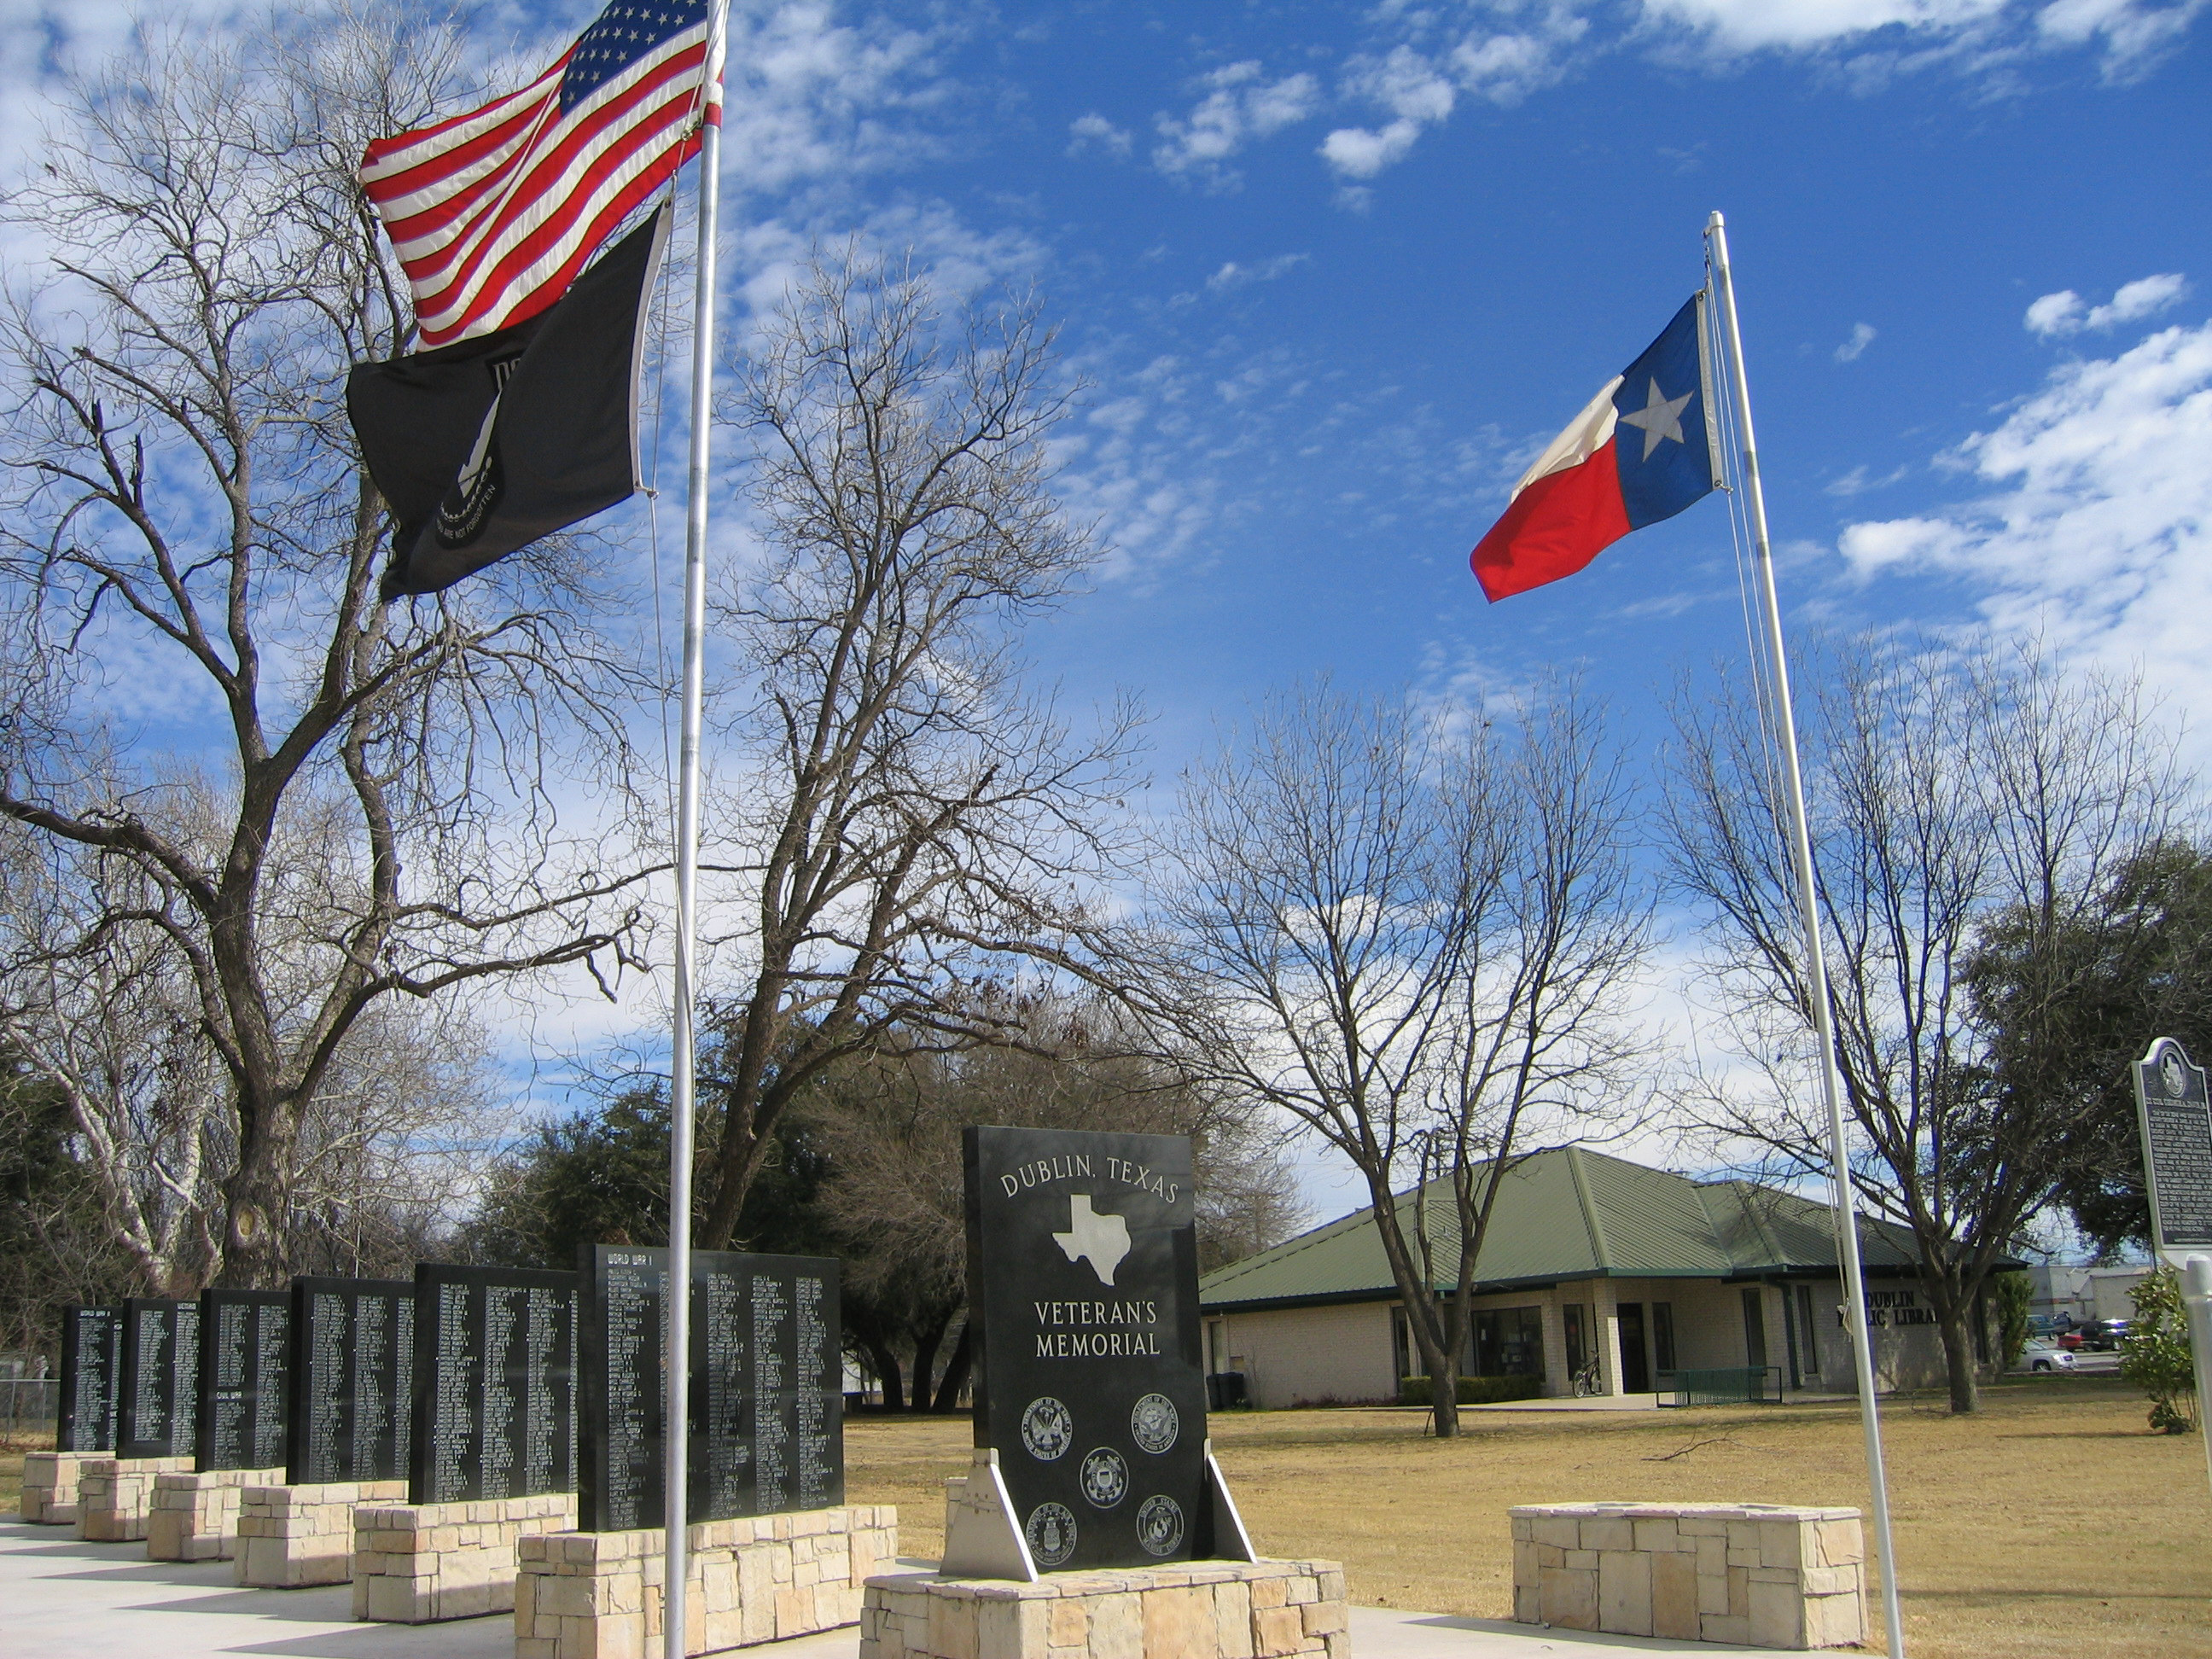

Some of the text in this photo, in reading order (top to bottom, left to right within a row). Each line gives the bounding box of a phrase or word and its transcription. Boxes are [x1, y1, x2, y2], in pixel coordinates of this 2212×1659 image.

[1106, 1156, 1179, 1203] TEXAS
[1864, 1289, 1914, 1307] DUBLIN
[1033, 1301, 1157, 1324] VETERAN'S
[1894, 1307, 1939, 1324] LIBRA
[1036, 1332, 1161, 1357] MEMORIAL
